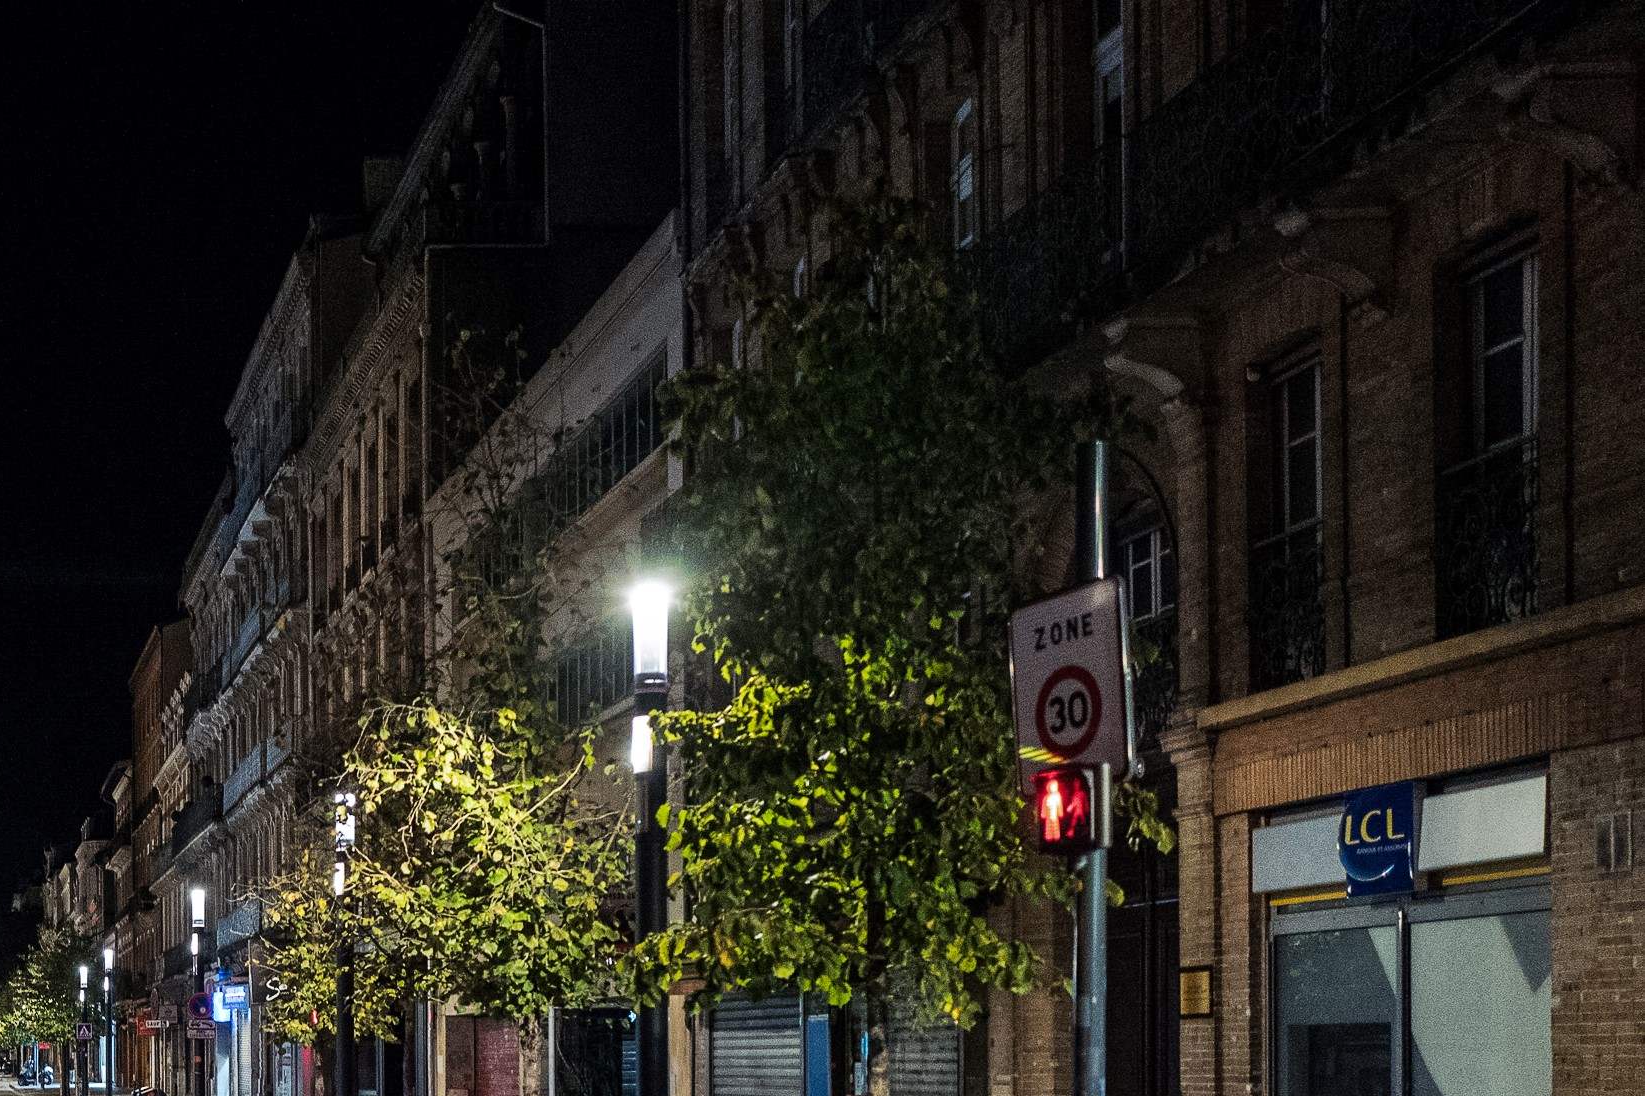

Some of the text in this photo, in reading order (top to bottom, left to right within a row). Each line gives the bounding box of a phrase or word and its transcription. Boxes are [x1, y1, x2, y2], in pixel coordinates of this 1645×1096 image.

[1033, 612, 1094, 652] ZONE
[1048, 690, 1089, 735] 30
[1345, 808, 1405, 845] LCL
